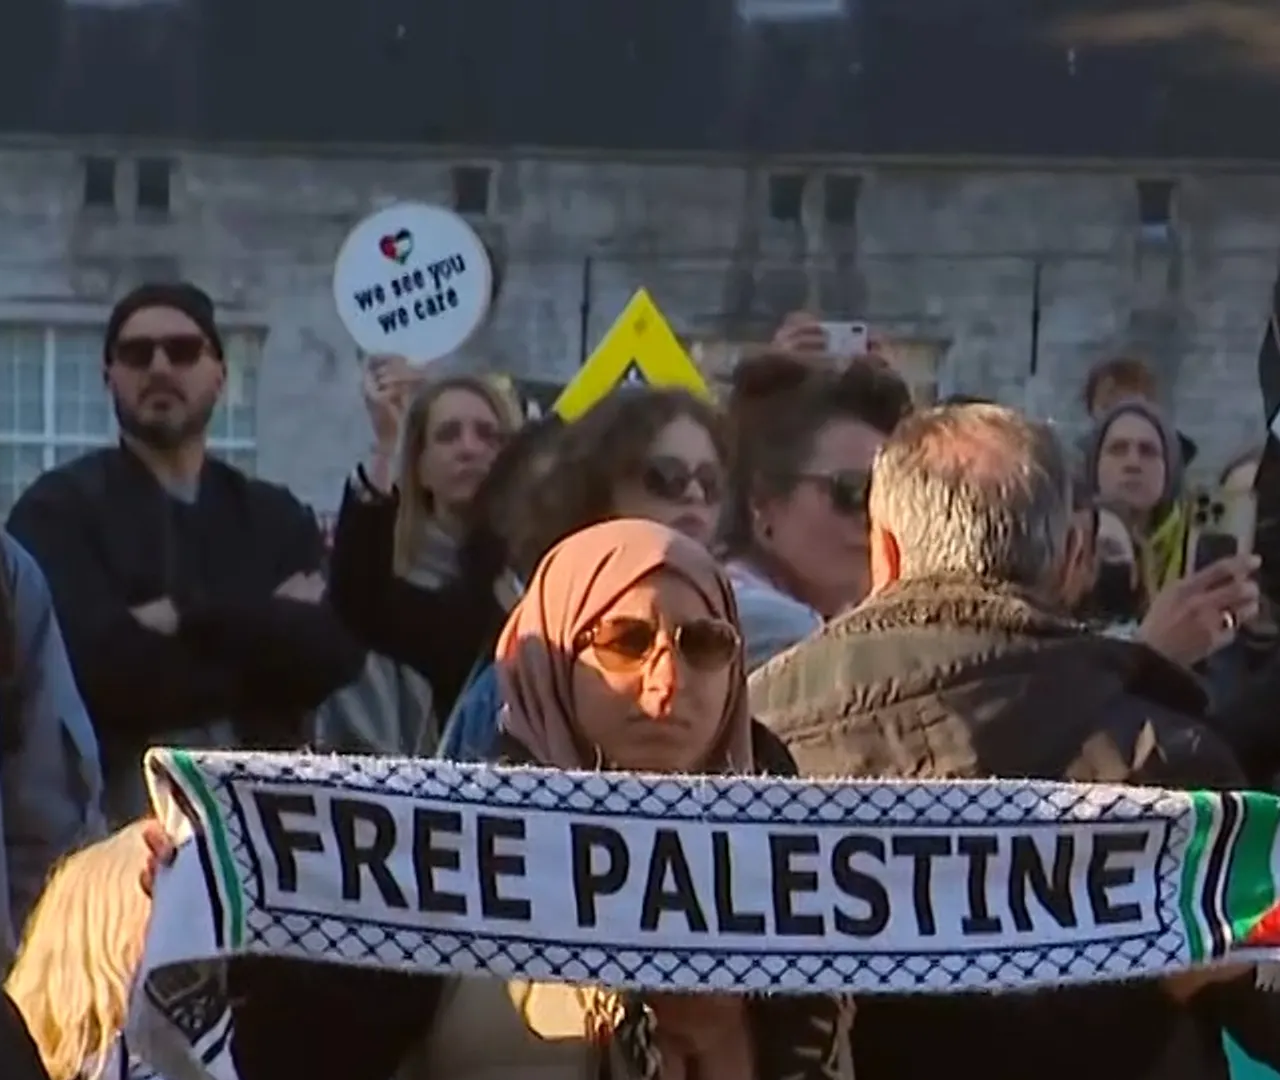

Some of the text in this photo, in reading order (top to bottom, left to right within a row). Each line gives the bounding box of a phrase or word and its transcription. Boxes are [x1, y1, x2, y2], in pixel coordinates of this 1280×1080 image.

[353, 253, 467, 312] we see you
[376, 287, 459, 336] we care
[265, 796, 1151, 939] FREE PALESTINE
